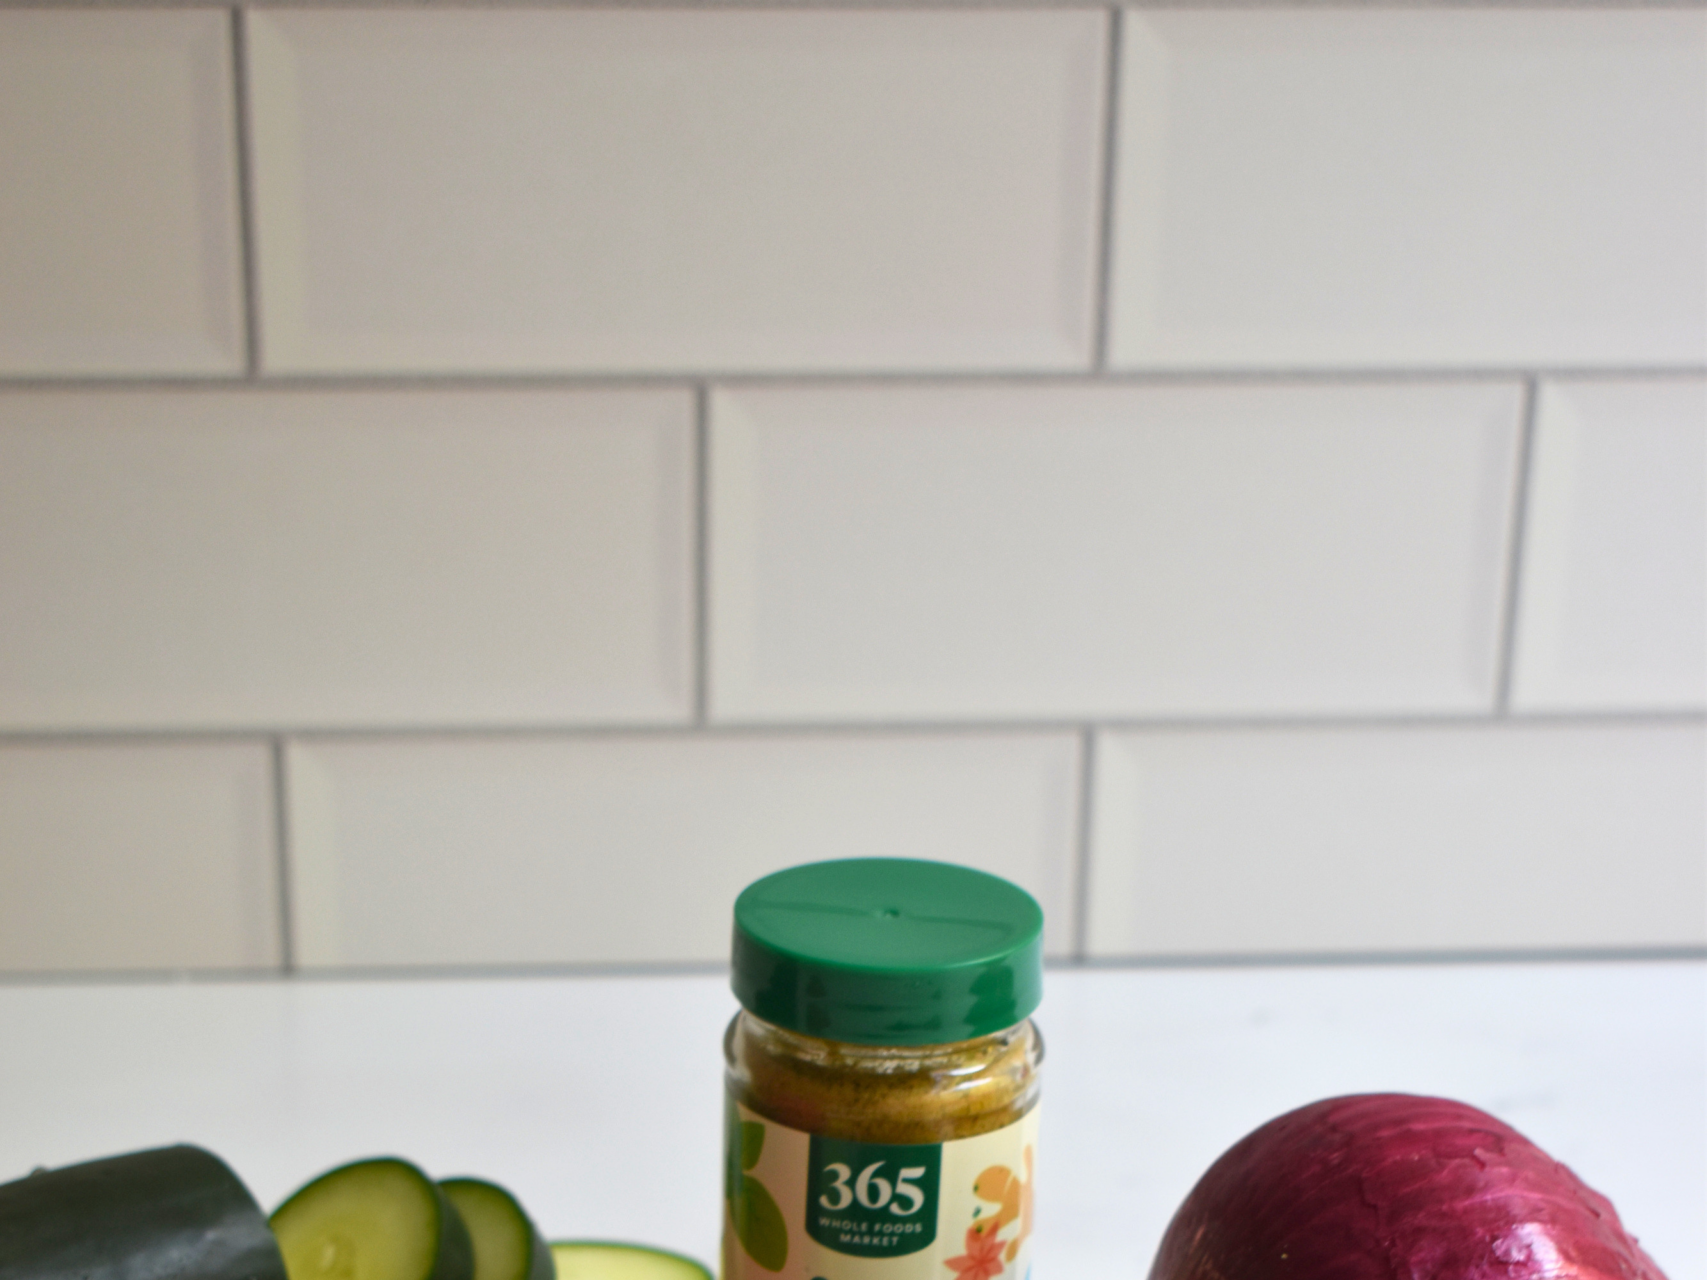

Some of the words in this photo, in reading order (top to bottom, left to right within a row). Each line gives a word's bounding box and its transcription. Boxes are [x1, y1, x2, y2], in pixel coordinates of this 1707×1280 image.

[819, 1160, 926, 1216] 365
[818, 1217, 869, 1232] WHOLE
[874, 1222, 923, 1234] FOODS
[839, 1233, 899, 1247] MARKET
